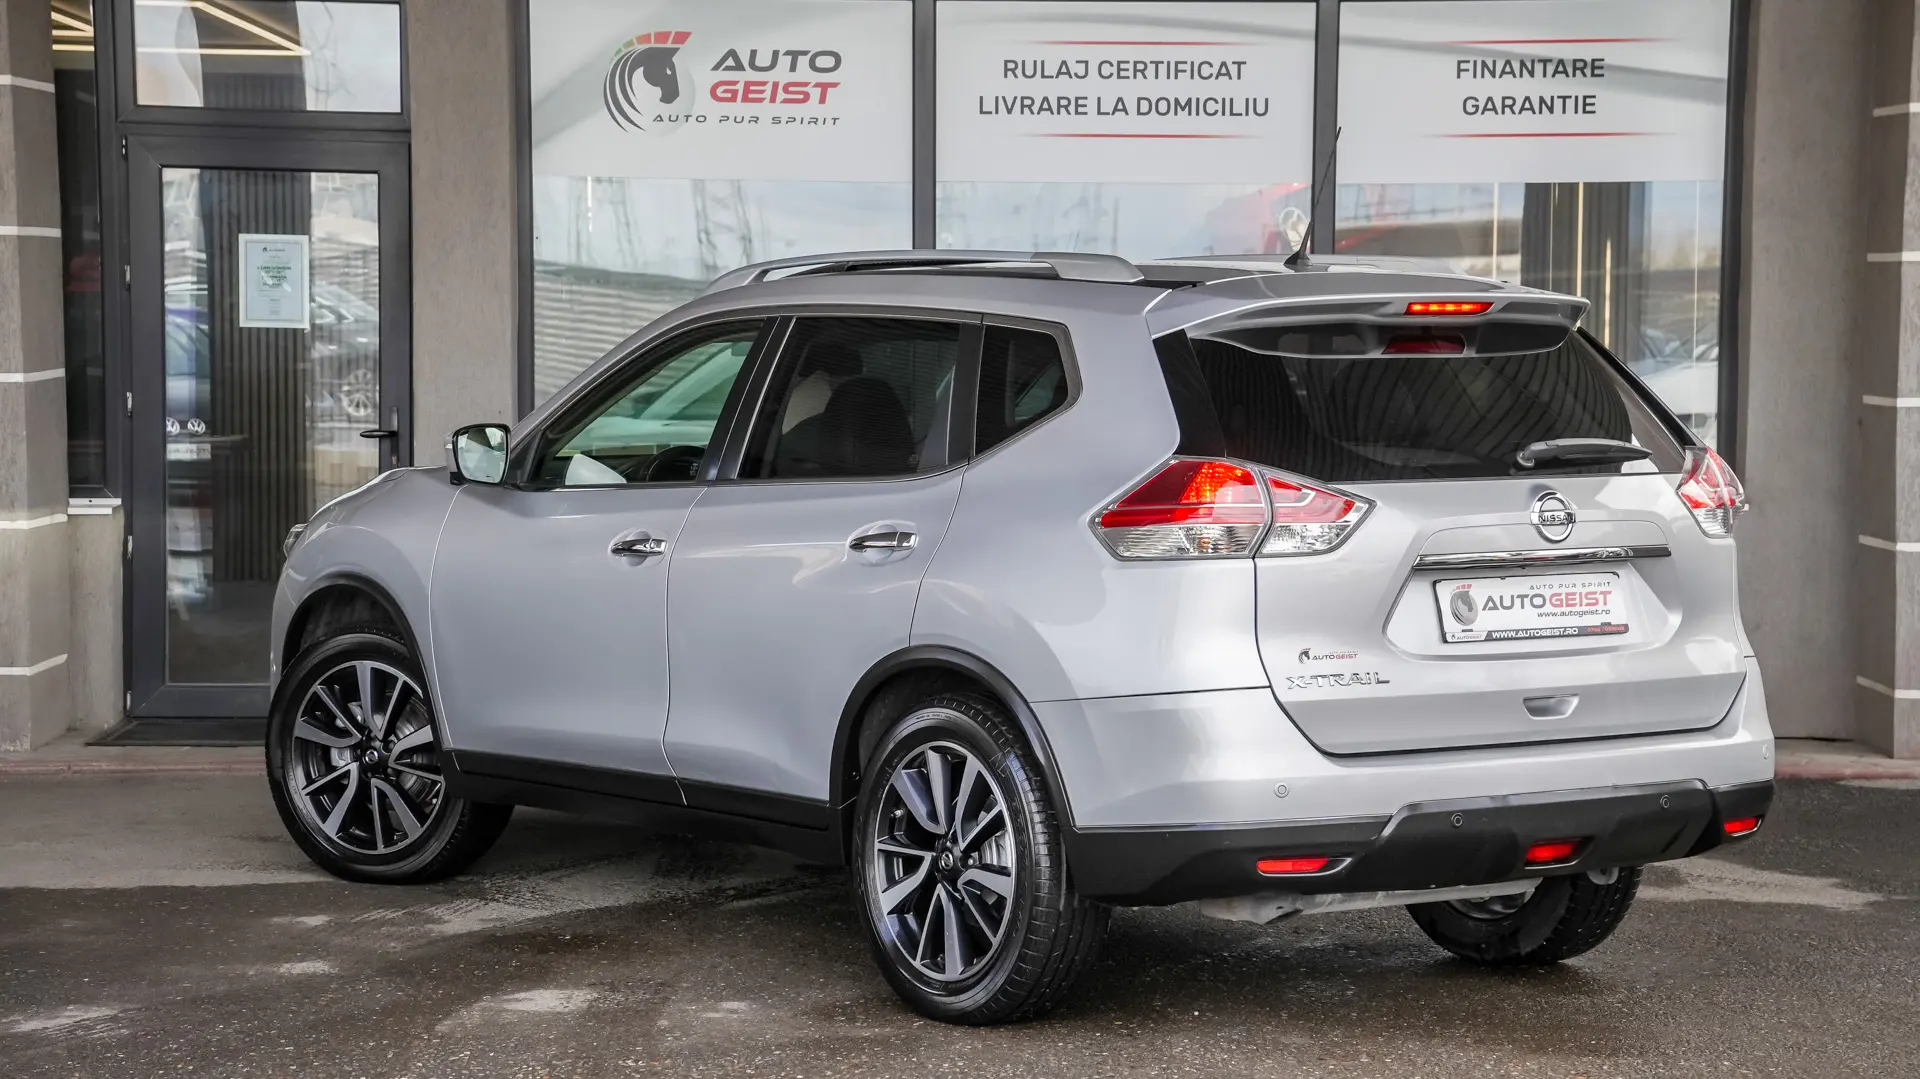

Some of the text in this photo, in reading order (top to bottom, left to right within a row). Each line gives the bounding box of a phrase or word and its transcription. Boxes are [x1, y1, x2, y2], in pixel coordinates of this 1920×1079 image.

[710, 48, 842, 73] AUTO
[1003, 59, 1247, 81] RULAJ CERTIFICAT
[1456, 58, 1605, 79] FINANTARE
[709, 80, 841, 104] GEIST
[979, 95, 1269, 117] LIVRARE LA DOMICILIU
[1462, 94, 1597, 116] GARANTIE
[653, 114, 841, 126] AUTO PUR SPIRIT
[1538, 514, 1573, 524] NISSAN
[1529, 583, 1554, 591] AUTO
[1482, 590, 1612, 611] AUTOGEIST
[1537, 608, 1611, 618] www.autogeist.ro
[1492, 627, 1579, 639] WWW.AUTOGEIST.RO
[1312, 653, 1359, 661] AUTOGEIST
[1286, 671, 1391, 690] X-TRAIL
